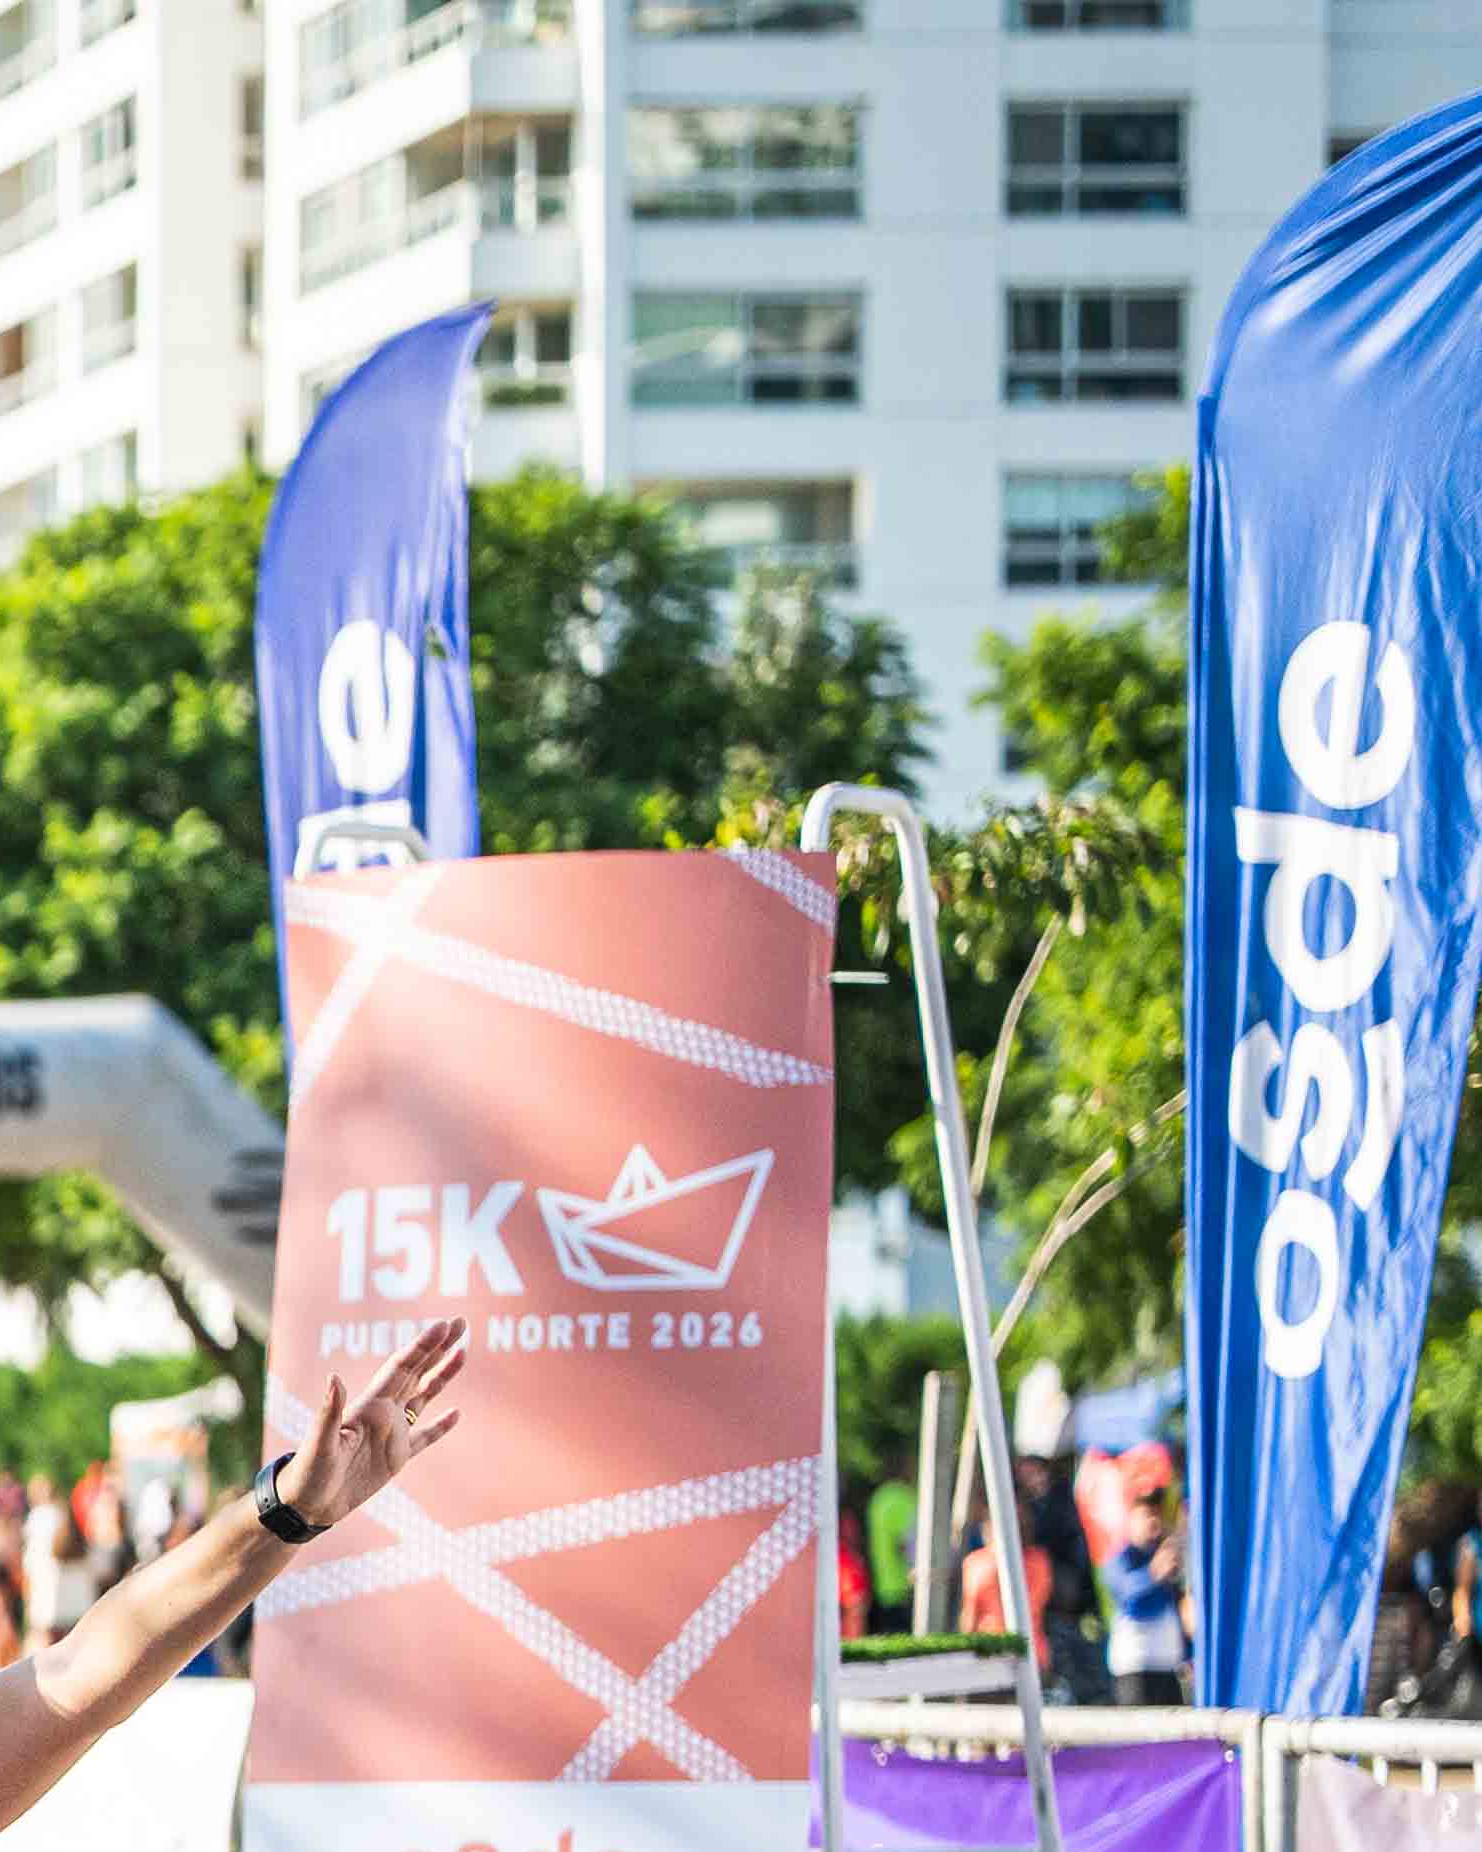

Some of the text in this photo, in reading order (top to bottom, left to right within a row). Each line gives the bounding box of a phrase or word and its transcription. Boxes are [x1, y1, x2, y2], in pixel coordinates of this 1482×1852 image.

[1227, 620, 1415, 1379] osde
[326, 1179, 527, 1304] 15K
[487, 1312, 631, 1353] NORTE
[651, 1309, 765, 1348] 2026
